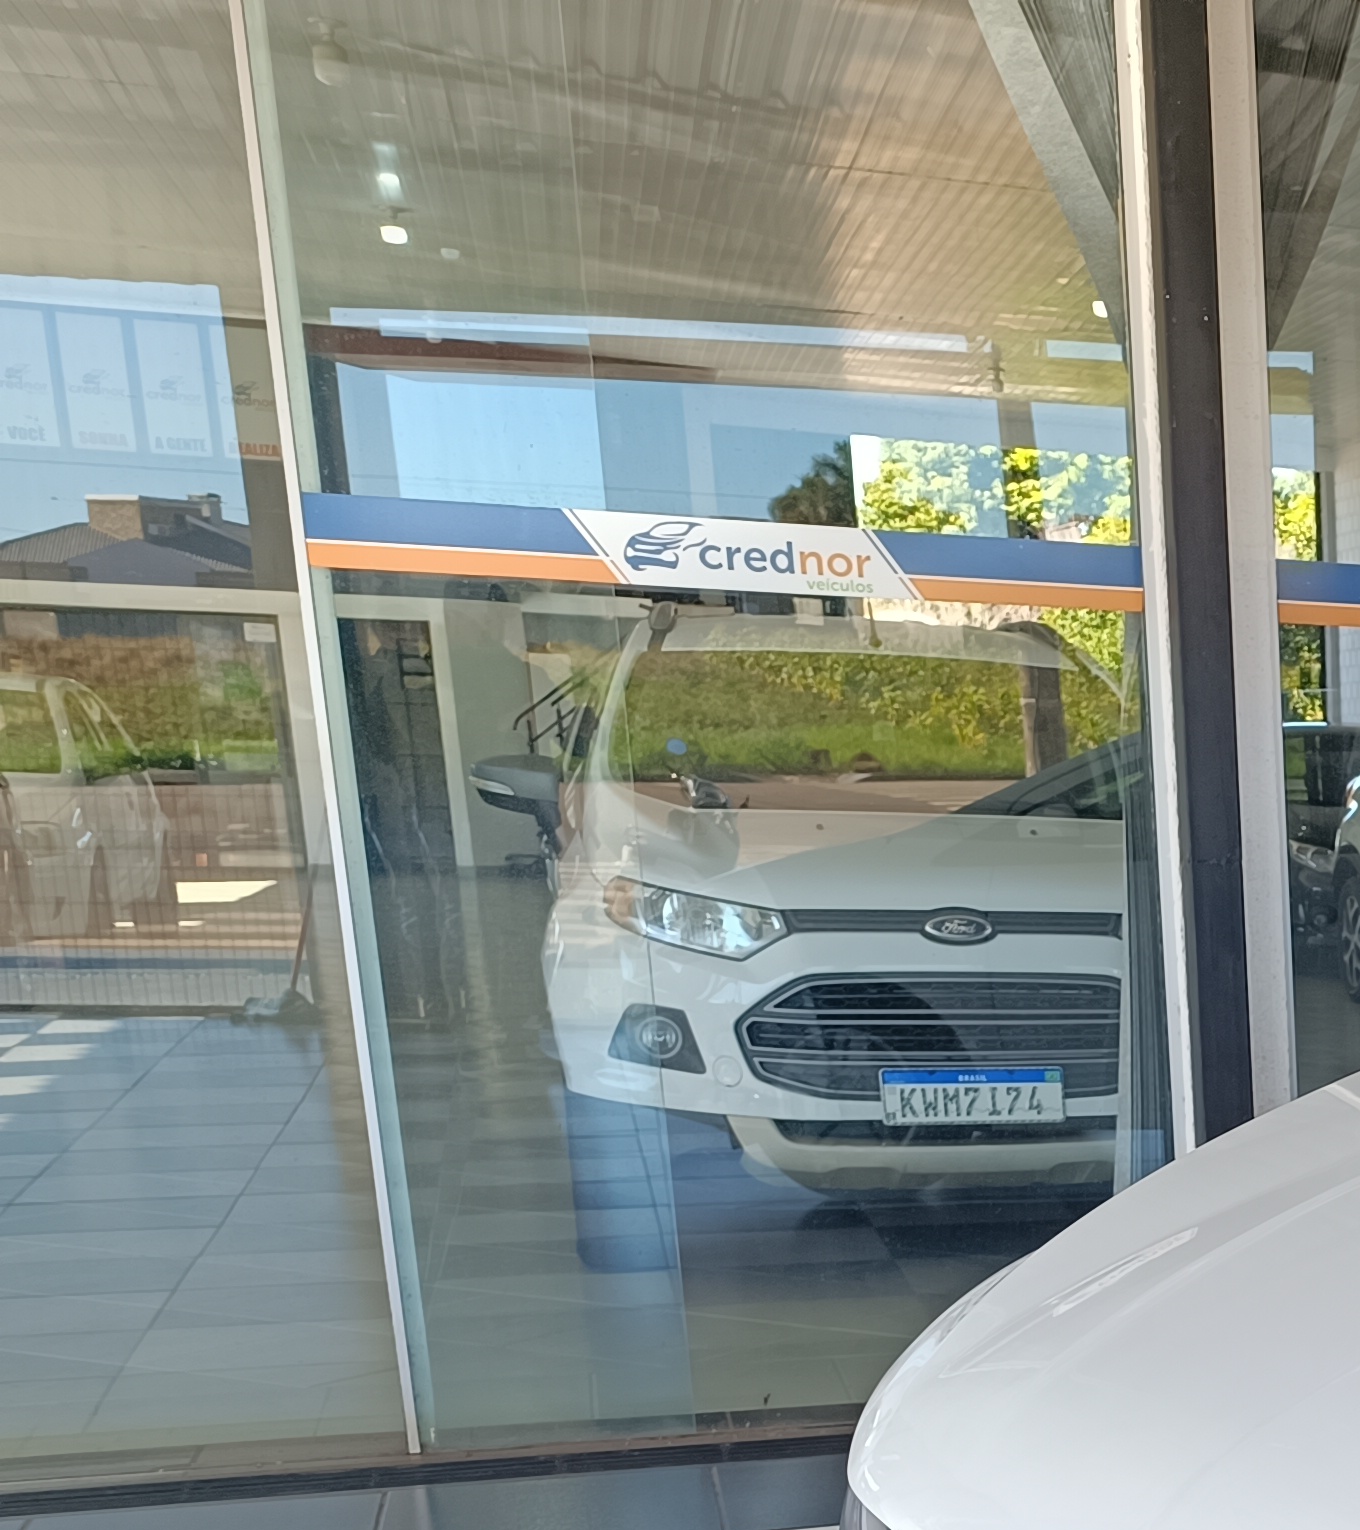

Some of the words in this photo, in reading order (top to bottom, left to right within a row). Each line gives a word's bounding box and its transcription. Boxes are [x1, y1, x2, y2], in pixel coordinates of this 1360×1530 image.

[699, 541, 871, 578] crednor
[806, 578, 874, 594] veículos
[941, 919, 977, 934] Ford
